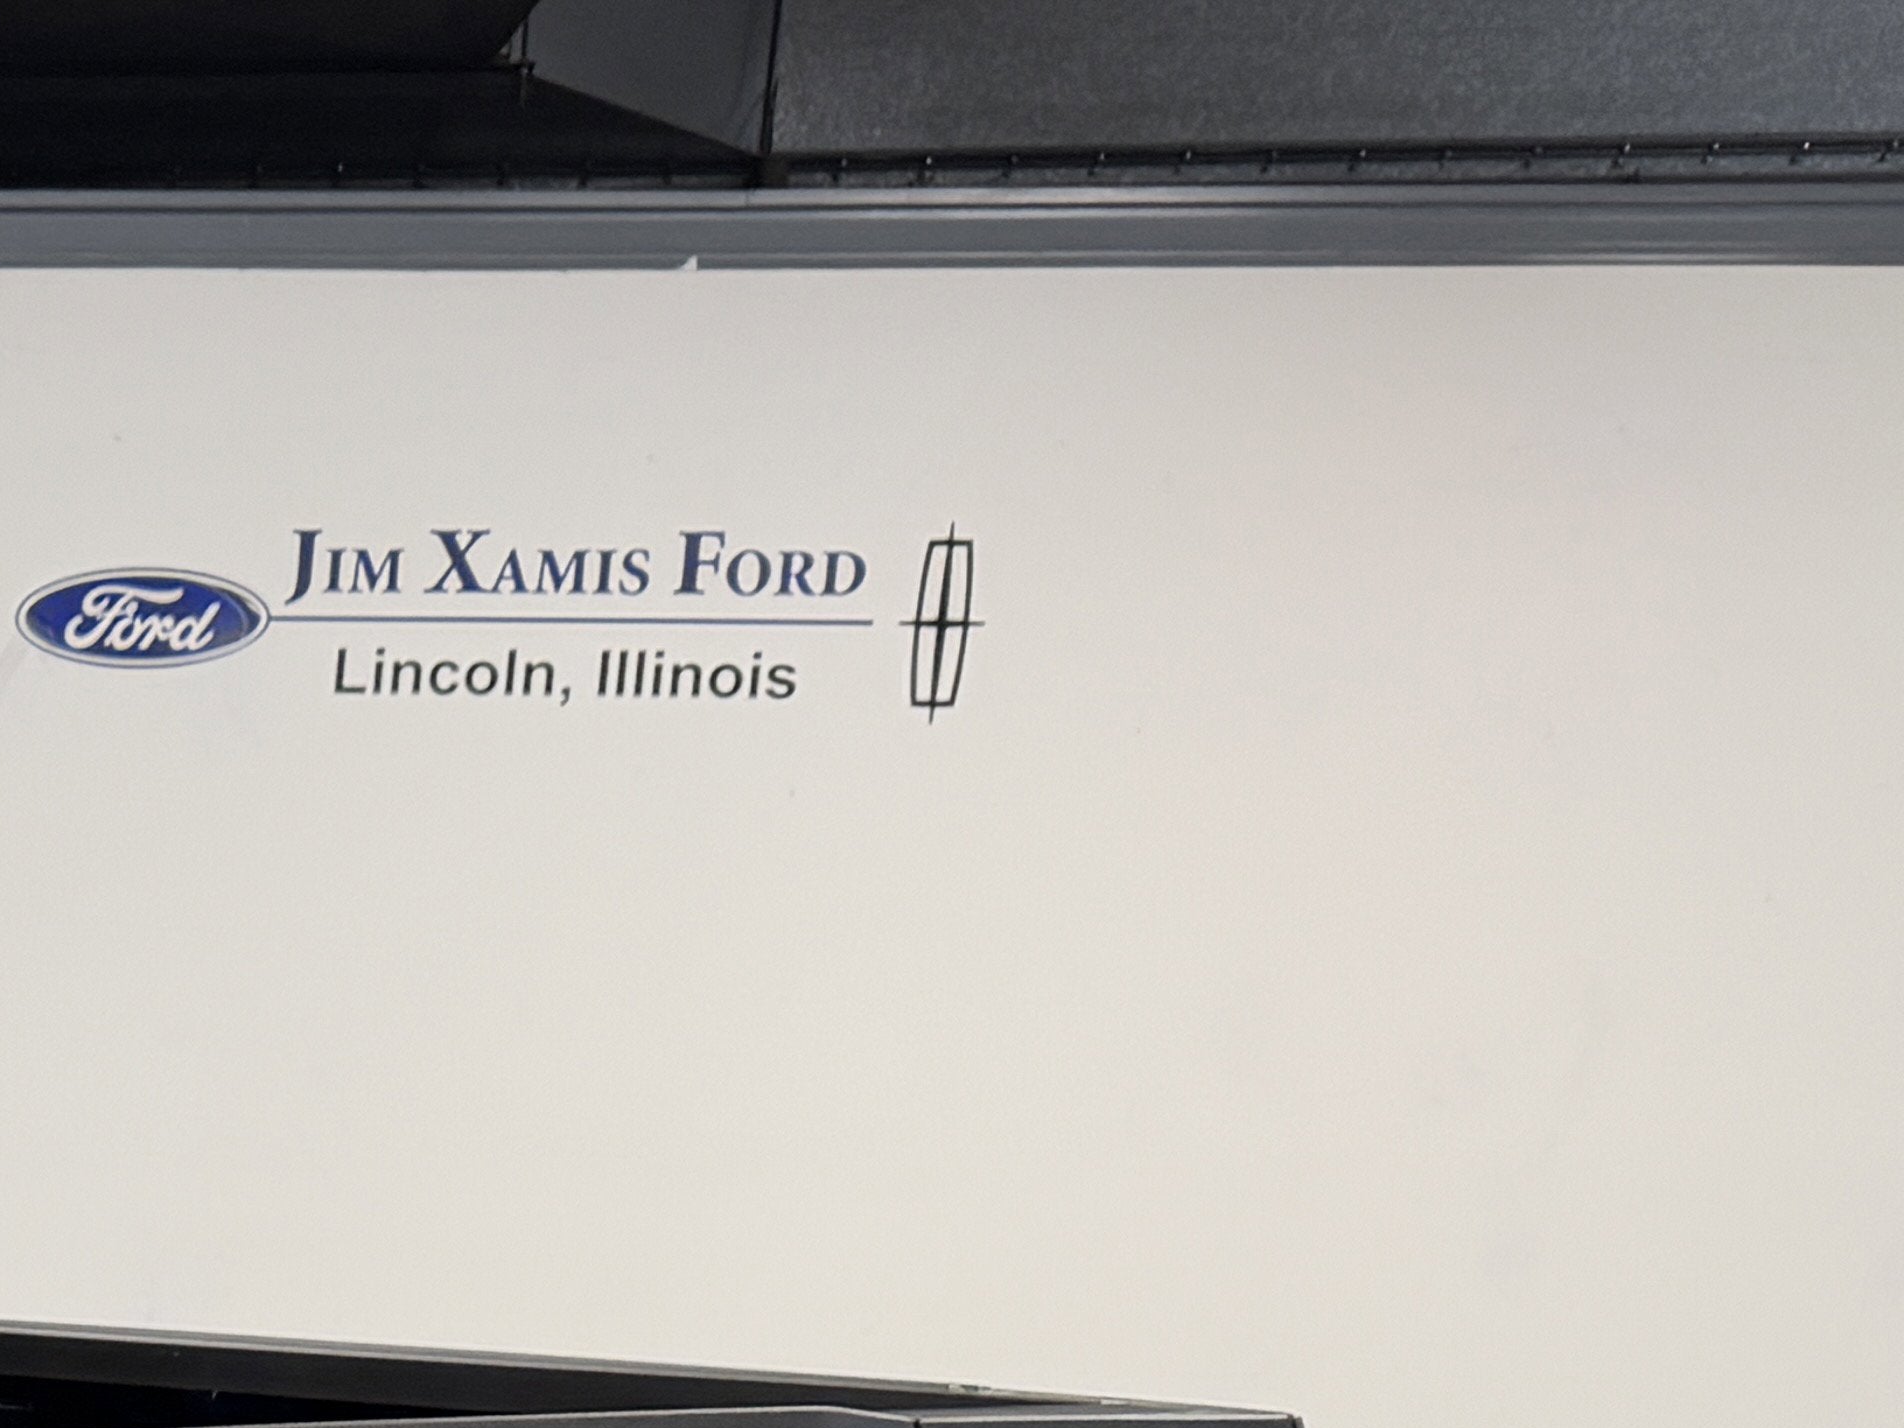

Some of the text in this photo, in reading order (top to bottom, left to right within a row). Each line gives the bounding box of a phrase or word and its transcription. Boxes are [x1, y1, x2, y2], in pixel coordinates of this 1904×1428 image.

[285, 528, 869, 606] JIM XAMIS FORD
[64, 584, 221, 651] Ford
[334, 647, 797, 705] Lincoln, Illinois
